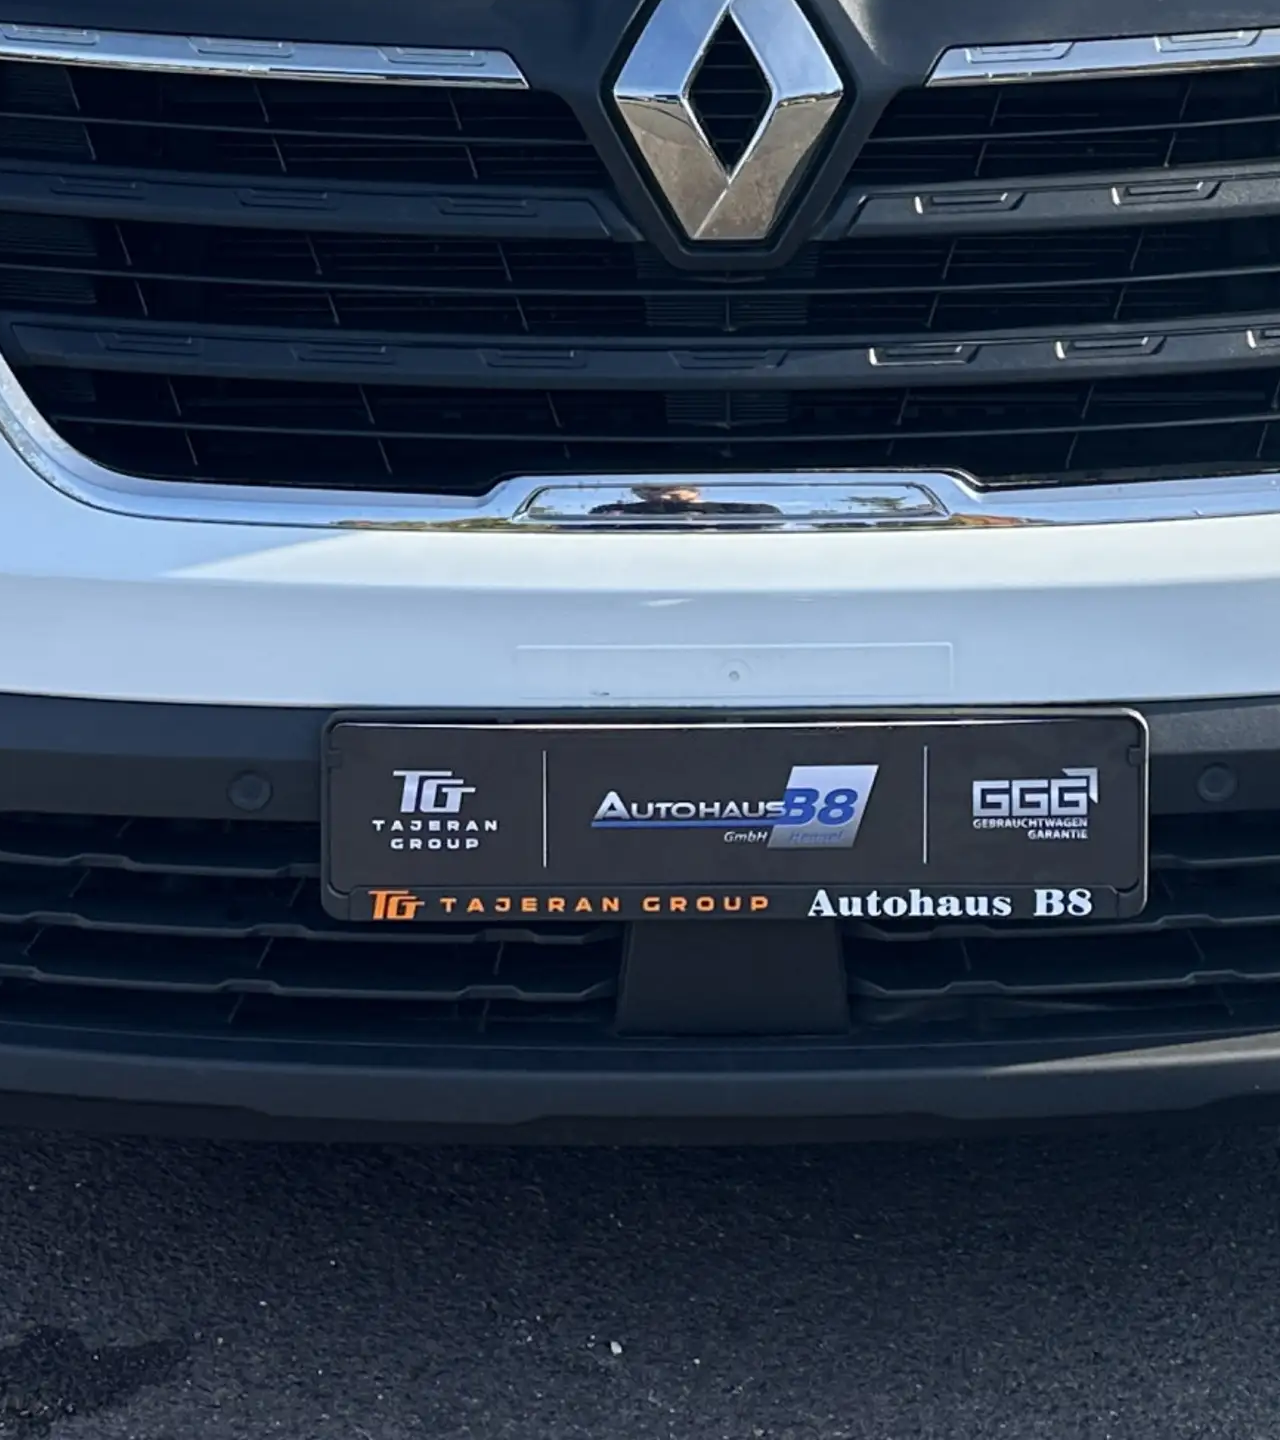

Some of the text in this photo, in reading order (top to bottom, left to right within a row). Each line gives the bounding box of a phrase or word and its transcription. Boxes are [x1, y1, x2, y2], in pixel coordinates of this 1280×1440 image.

[393, 770, 476, 813] TG
[972, 778, 1088, 817] GGG
[372, 820, 498, 831] TAJERAN
[972, 817, 1088, 829] GEBRAUCHTWAGEN
[723, 830, 768, 844] GmbH
[1027, 829, 1088, 840] GARANTIE
[390, 838, 480, 850] GROUP
[368, 890, 770, 920] TG TAJERAN GROUP
[807, 887, 1093, 918] Autohaus B8
